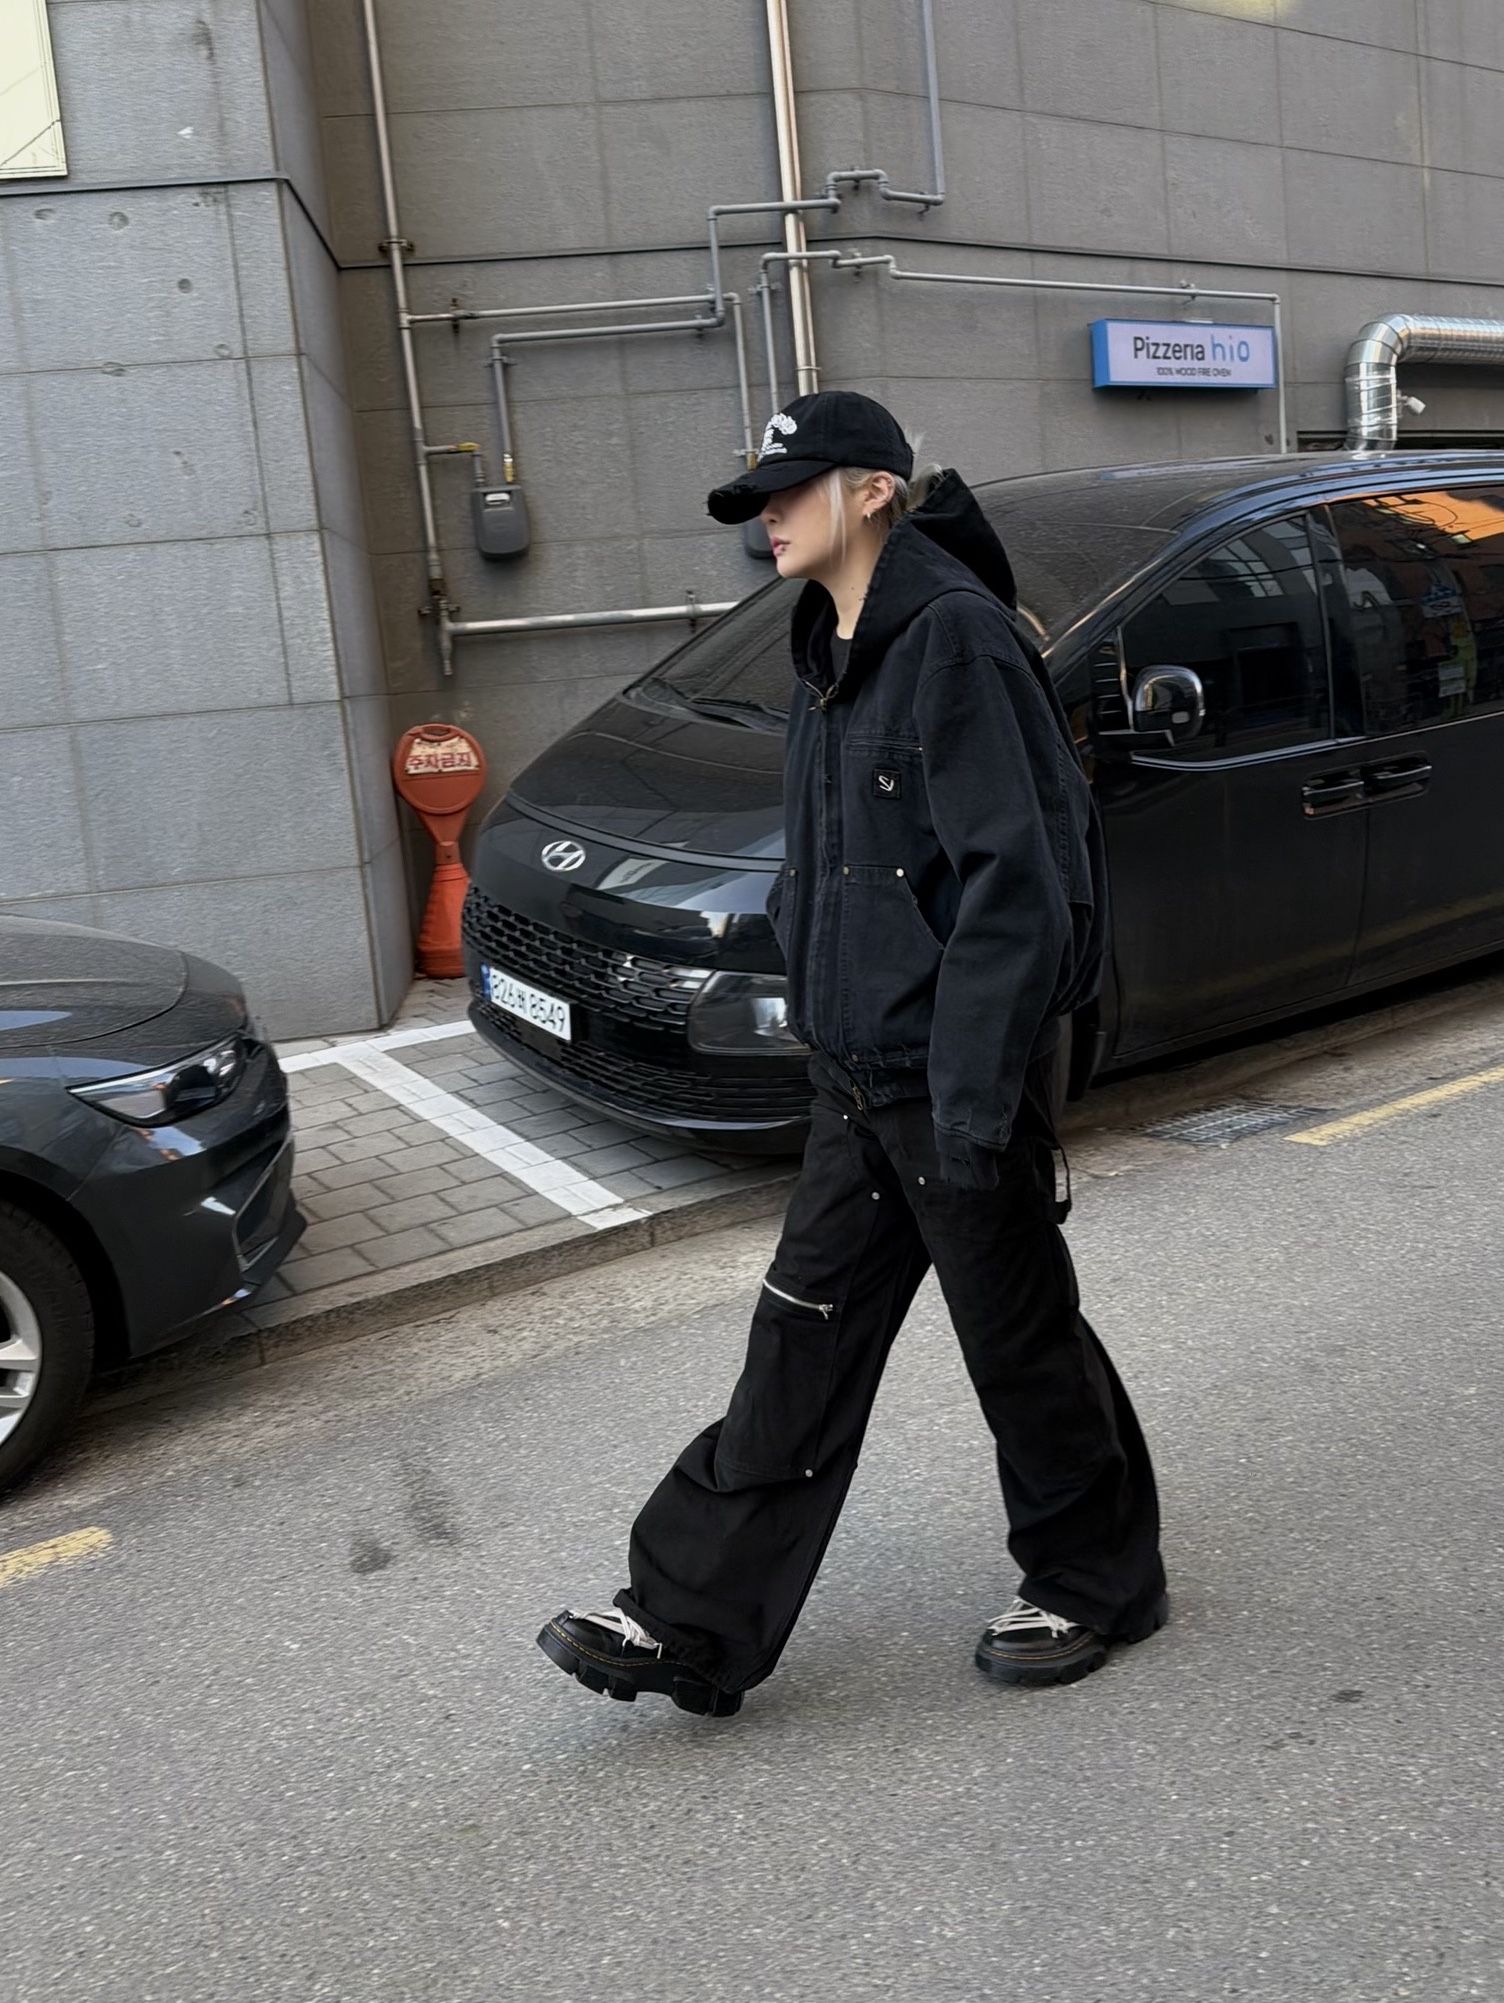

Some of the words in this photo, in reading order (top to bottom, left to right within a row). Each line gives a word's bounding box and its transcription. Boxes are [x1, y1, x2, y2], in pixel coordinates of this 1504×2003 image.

[1133, 336, 1205, 361] Pizzeria
[1212, 335, 1250, 362] hio
[1175, 367, 1197, 376] WOOD
[1198, 367, 1211, 377] FIRE
[408, 752, 471, 769] 주차금지
[529, 993, 566, 1033] 8549
